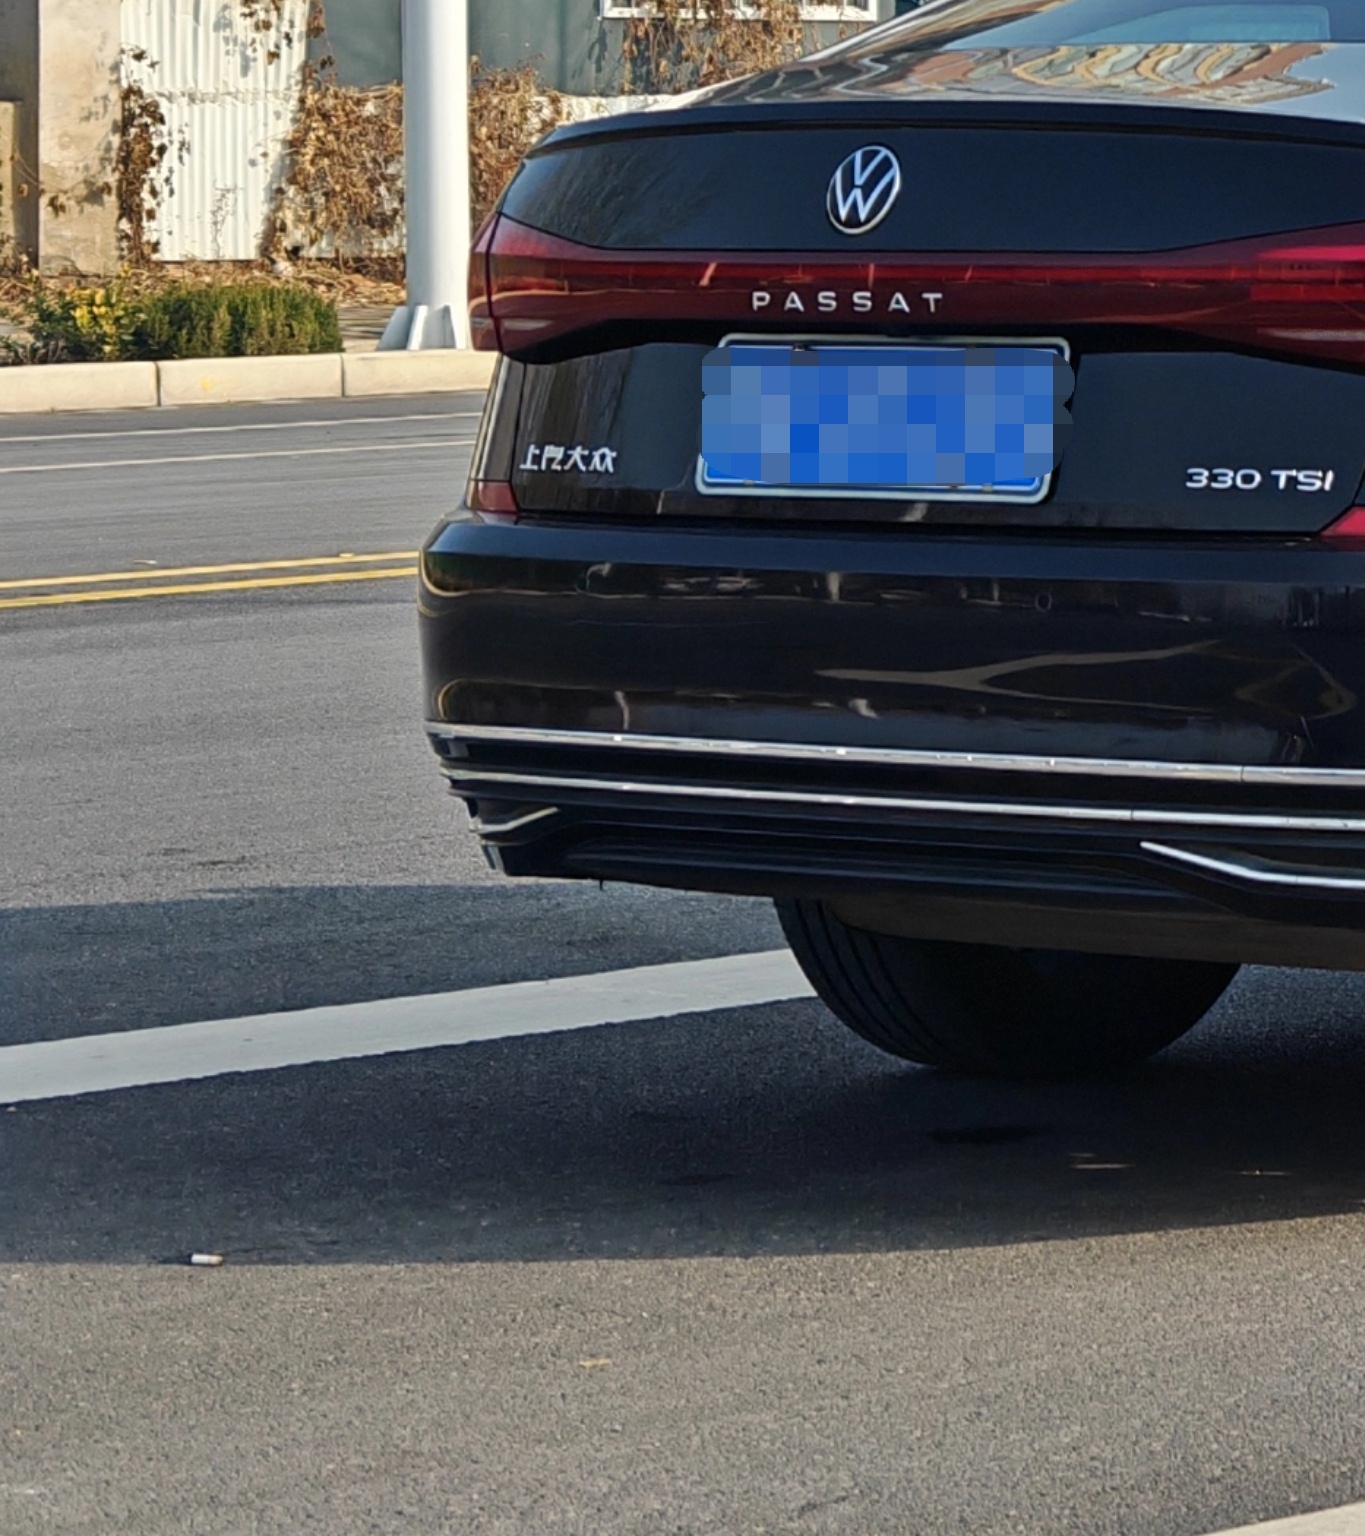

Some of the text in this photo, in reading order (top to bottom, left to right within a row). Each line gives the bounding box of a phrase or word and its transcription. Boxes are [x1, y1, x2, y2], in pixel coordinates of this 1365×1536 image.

[751, 291, 943, 312] PASSAT
[519, 444, 617, 473] 上汽大众
[1185, 467, 1334, 492] 330 TSI
